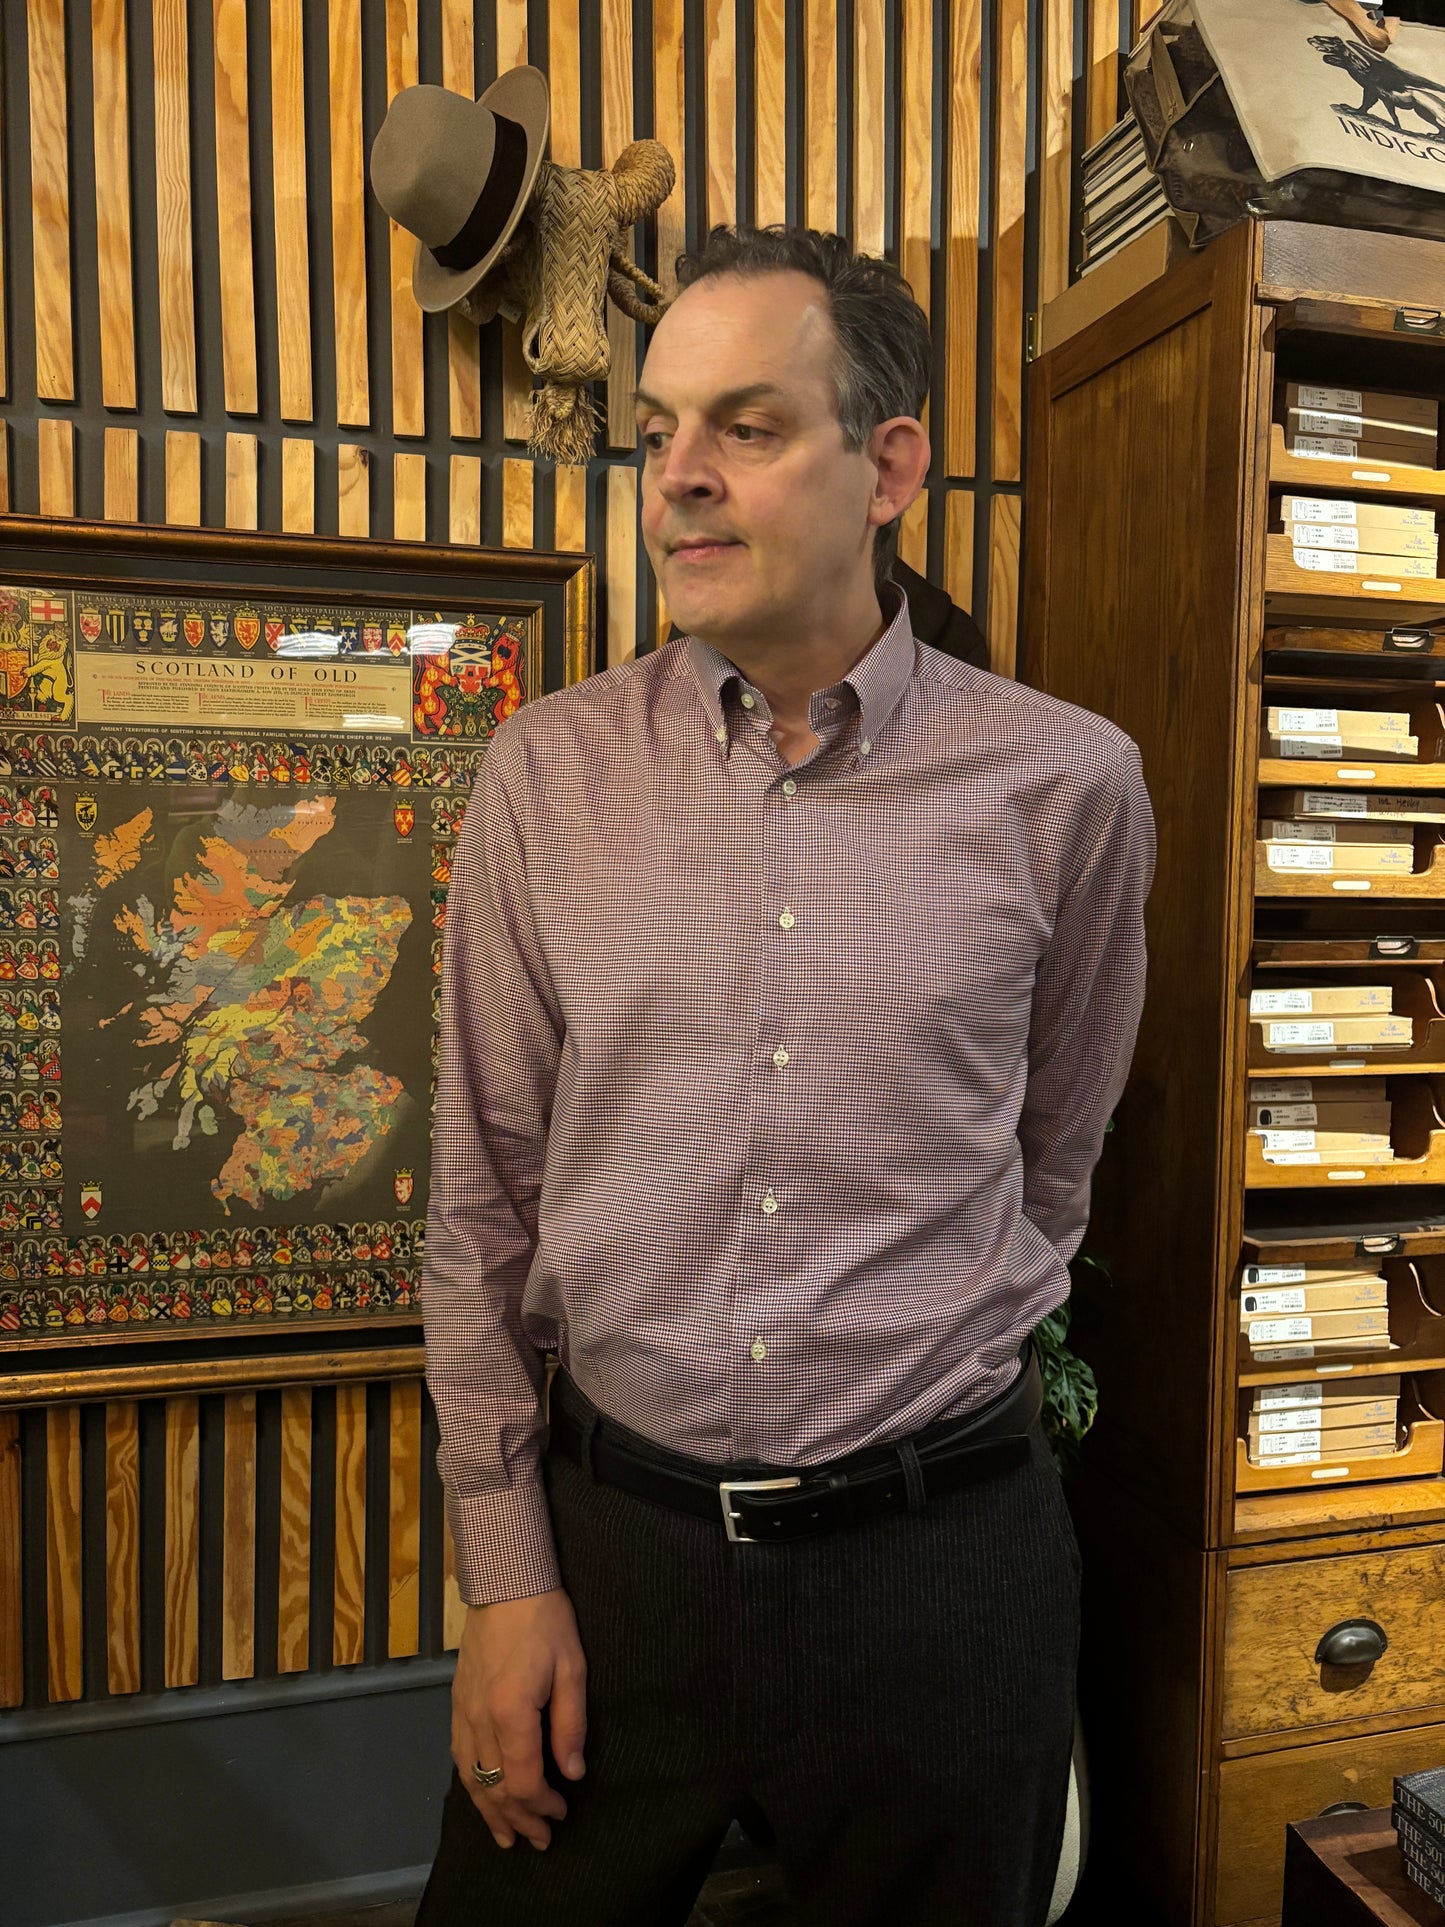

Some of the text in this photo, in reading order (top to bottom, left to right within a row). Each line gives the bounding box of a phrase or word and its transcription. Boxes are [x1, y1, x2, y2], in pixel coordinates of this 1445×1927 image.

[136, 660, 254, 679] SCOTLAND
[271, 666, 297, 680] OF
[314, 668, 357, 683] OLD
[1396, 1786, 1426, 1820] THE
[1395, 1813, 1442, 1868] THE 501
[1400, 1835, 1428, 1871] THE
[1404, 1858, 1432, 1895] THE
